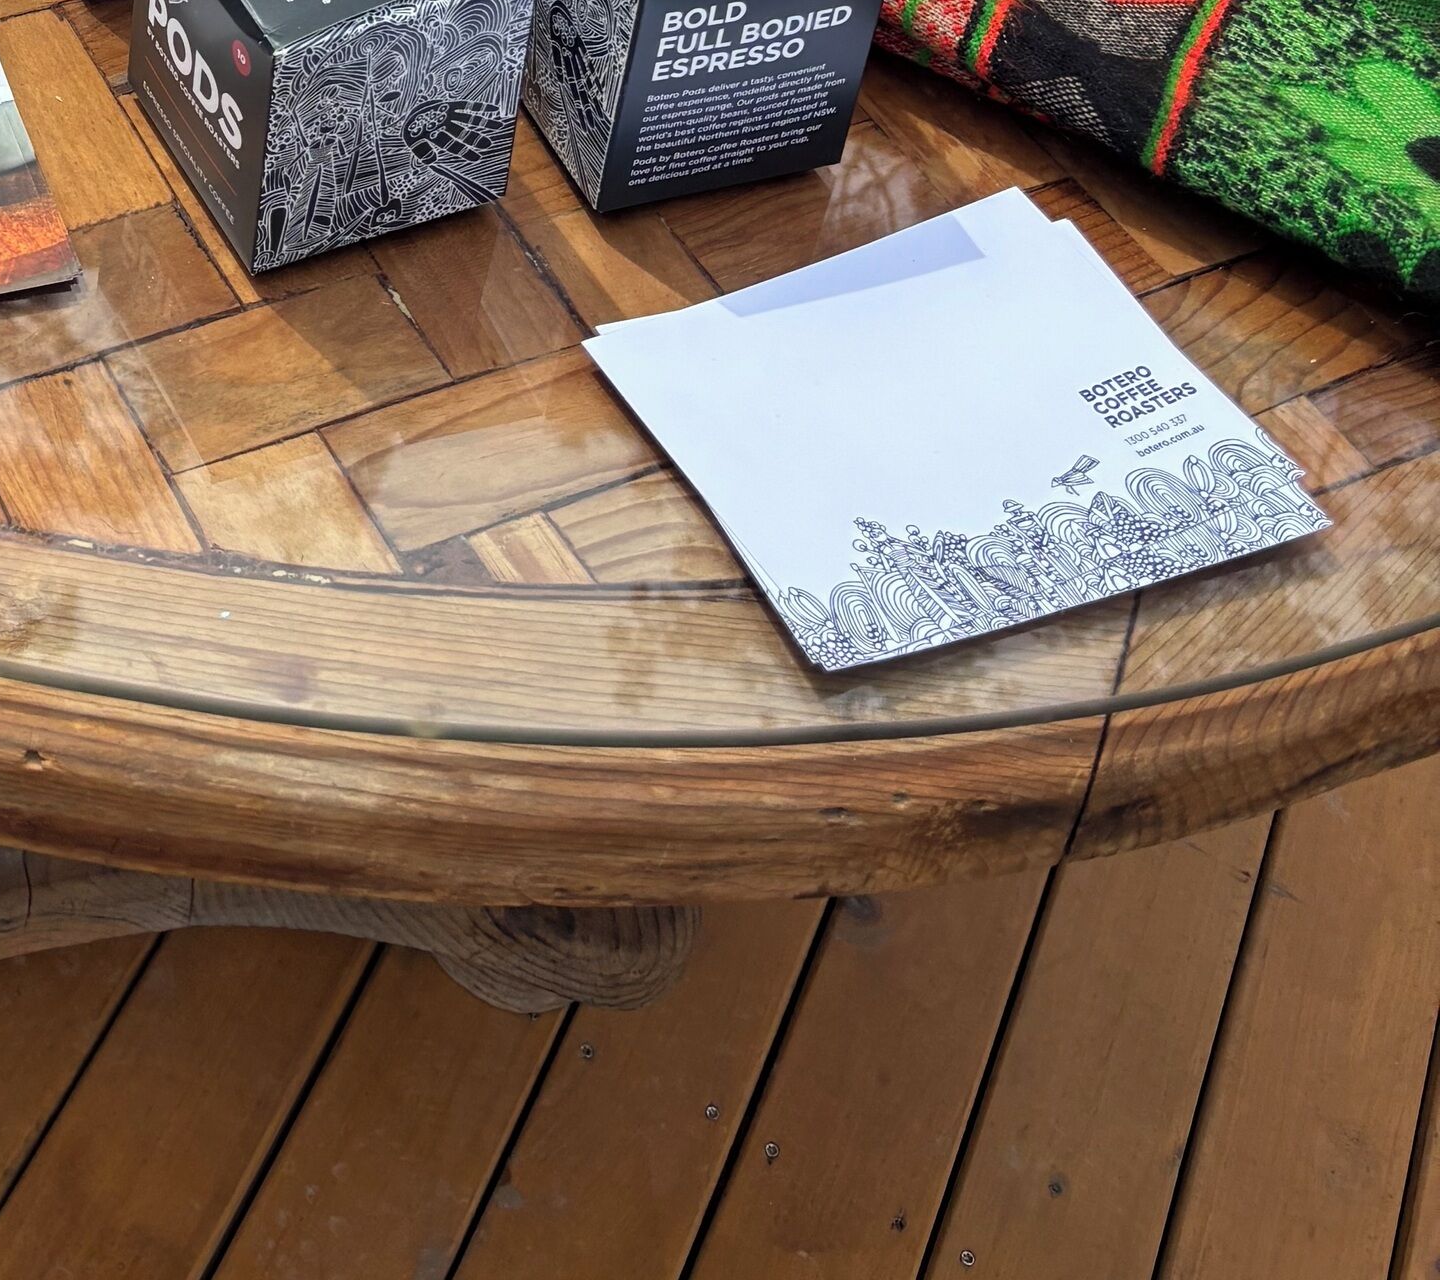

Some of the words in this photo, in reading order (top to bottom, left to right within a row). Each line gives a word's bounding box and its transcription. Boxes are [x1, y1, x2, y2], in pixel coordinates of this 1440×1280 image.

[657, 28, 732, 57] FULL
[740, 5, 851, 44] BODIED
[662, 1, 746, 33] BOLD
[651, 38, 804, 81] ESPRESSO
[1079, 366, 1152, 402] BOTERO
[1092, 379, 1163, 414] COFFEE
[1104, 382, 1197, 428] ROASTERS
[1125, 431, 1150, 446] 1300
[1148, 422, 1170, 436] 540
[1169, 414, 1187, 427] 337
[1136, 424, 1205, 457] botero.com.au
